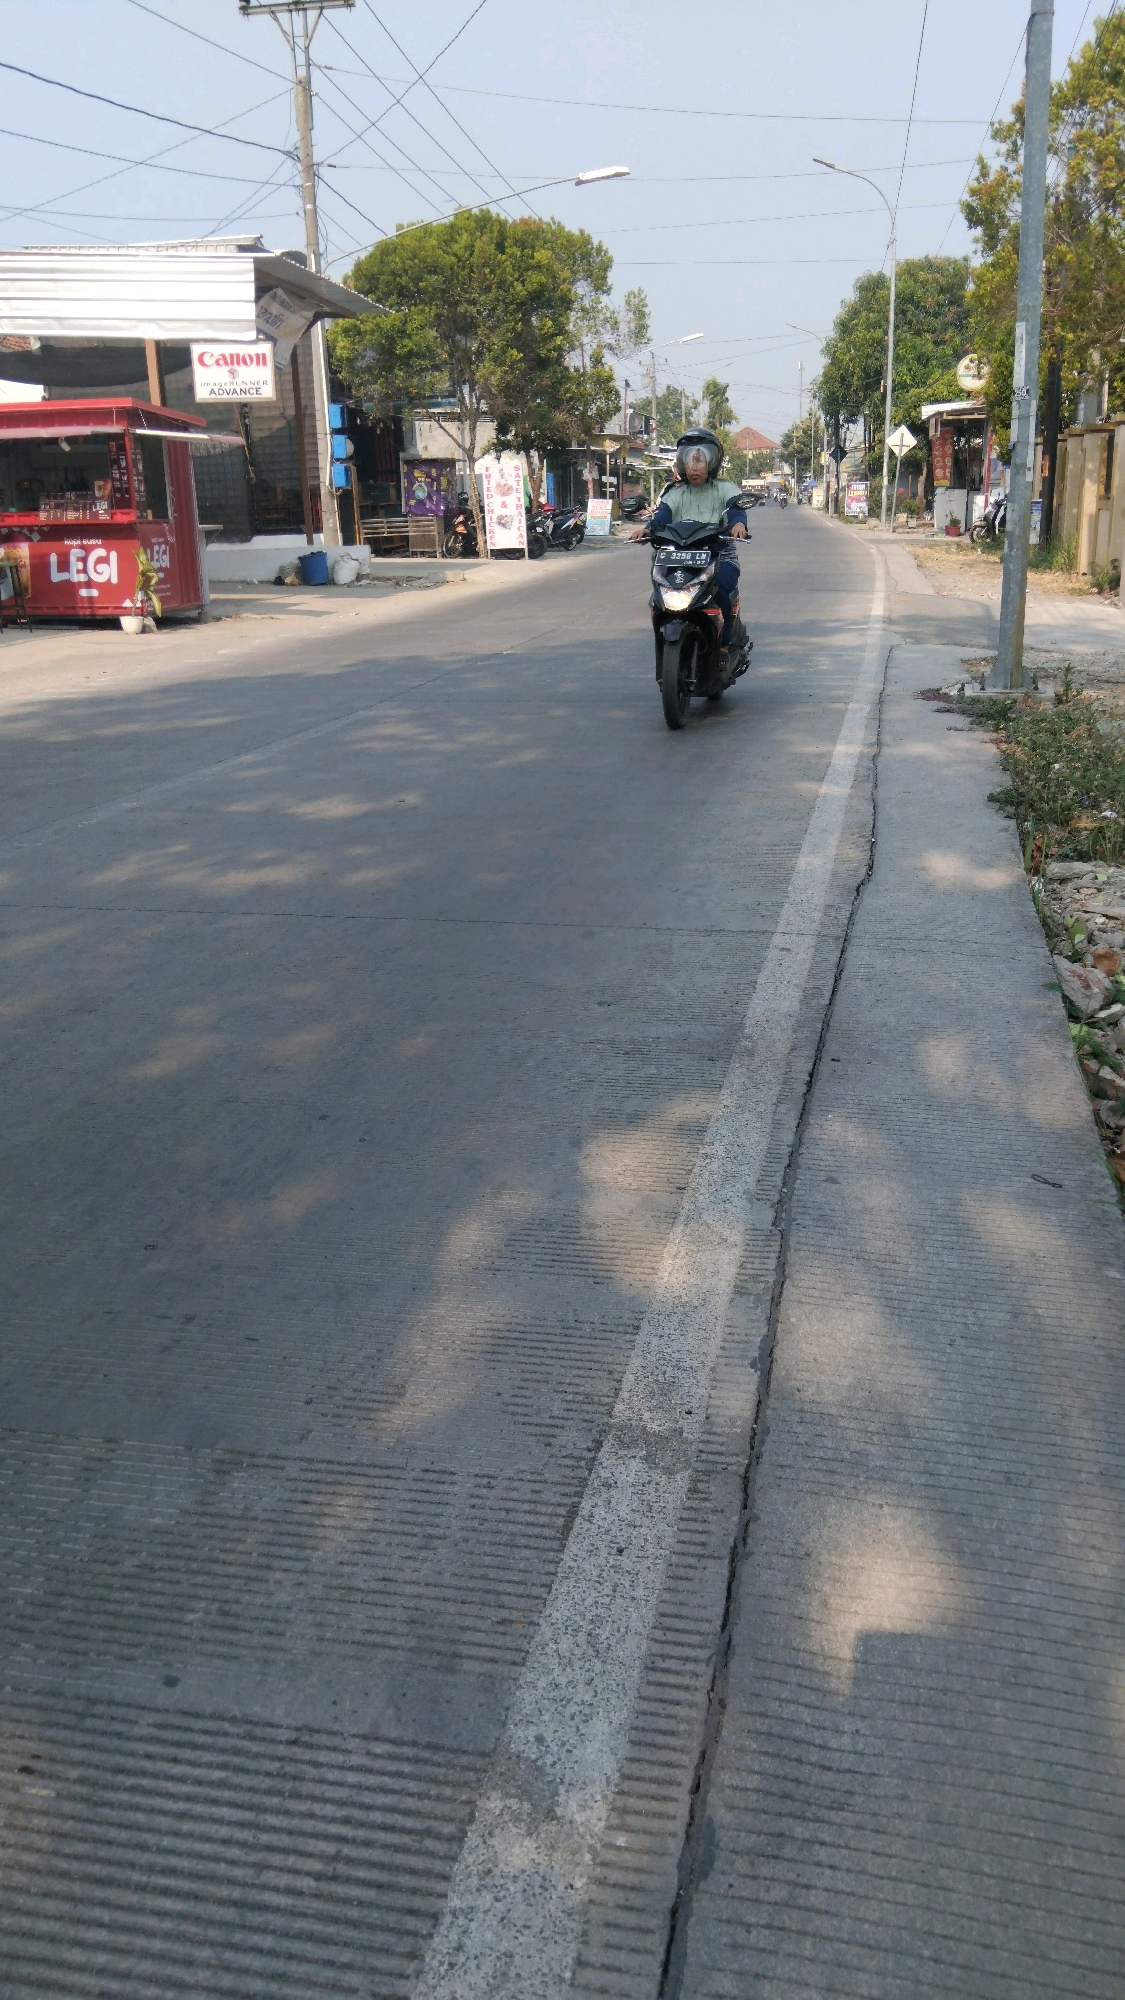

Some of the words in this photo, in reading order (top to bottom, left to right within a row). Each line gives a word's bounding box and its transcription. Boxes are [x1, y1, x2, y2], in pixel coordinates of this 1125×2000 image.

[198, 351, 267, 368] Canon
[209, 387, 262, 396] ADVANCE
[50, 548, 118, 584] LEGI
